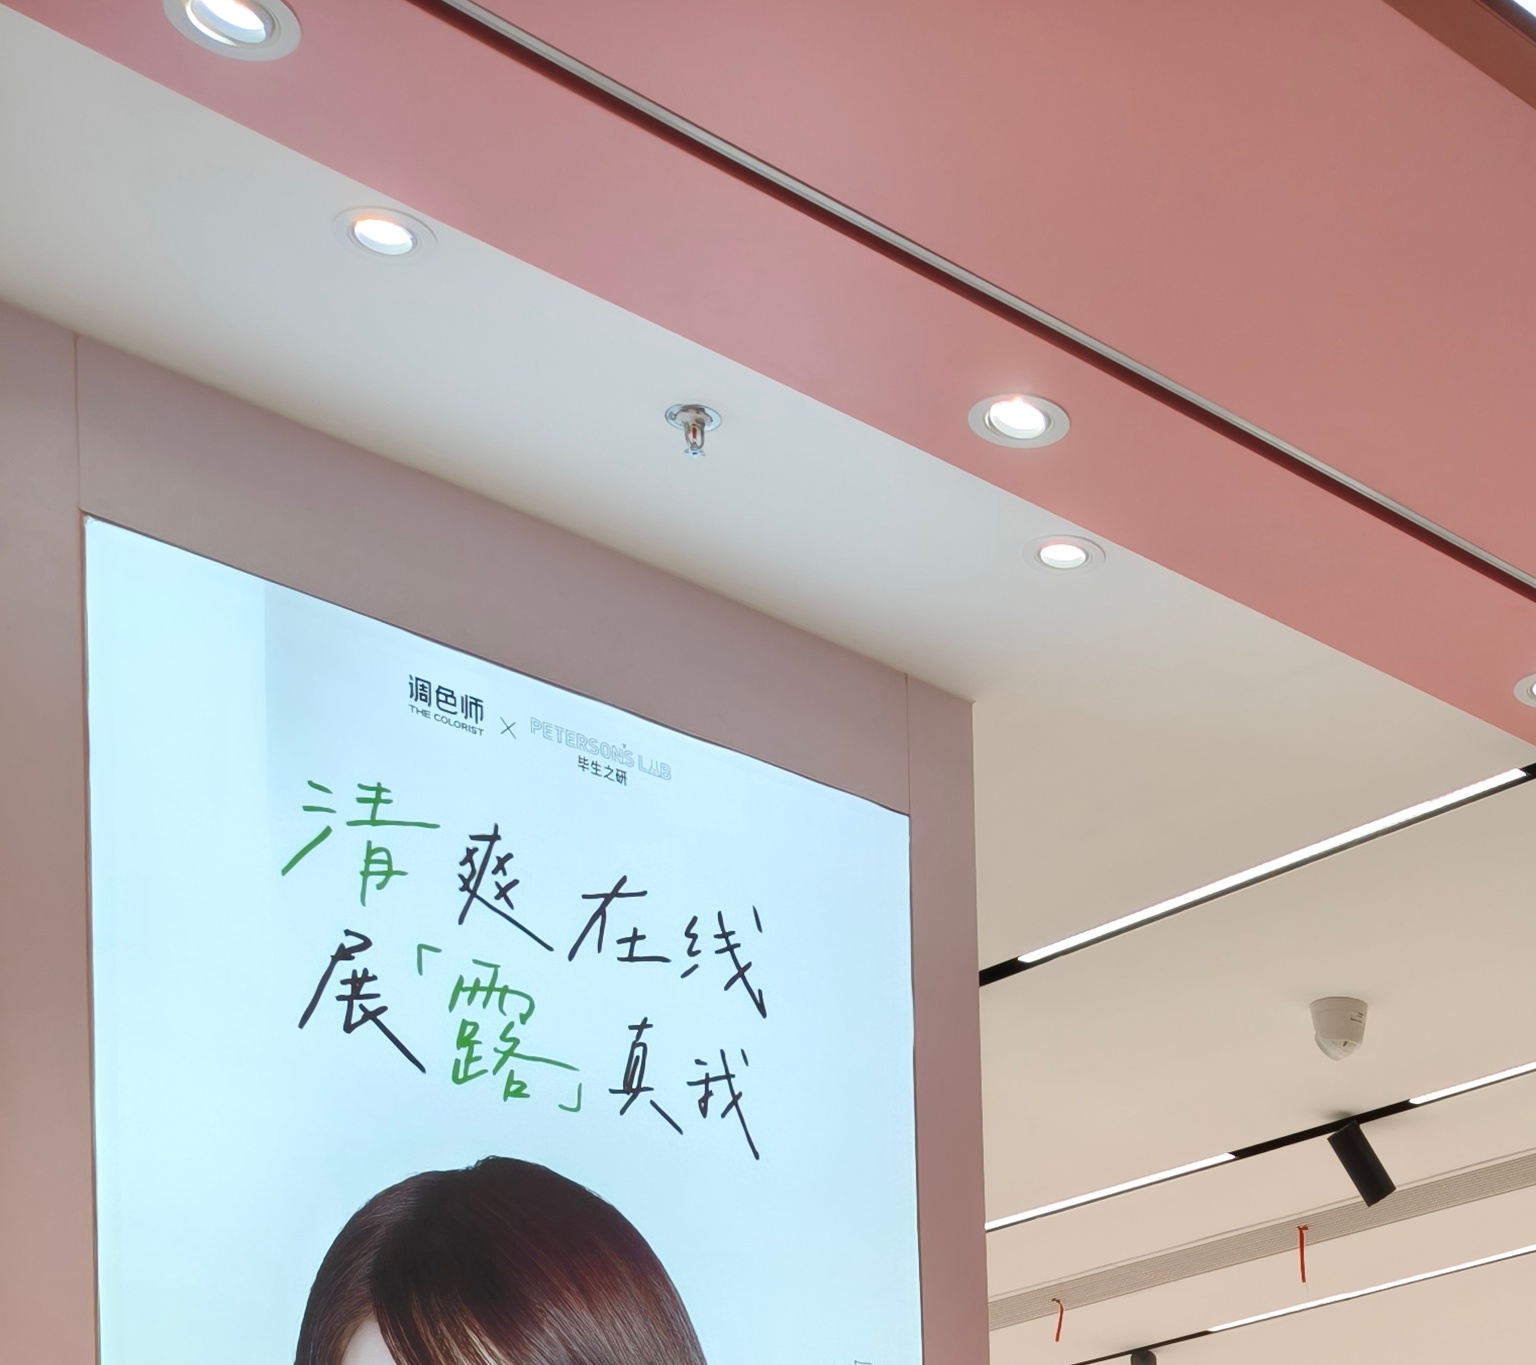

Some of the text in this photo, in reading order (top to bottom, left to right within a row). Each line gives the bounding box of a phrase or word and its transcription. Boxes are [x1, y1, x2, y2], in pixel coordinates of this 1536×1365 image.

[408, 674, 485, 724] 调色师
[408, 704, 485, 736] THE COLORIST
[530, 716, 672, 781] PETERSON'S LAB
[577, 755, 627, 786] 毕生之研
[281, 782, 768, 1018] 清爽在线
